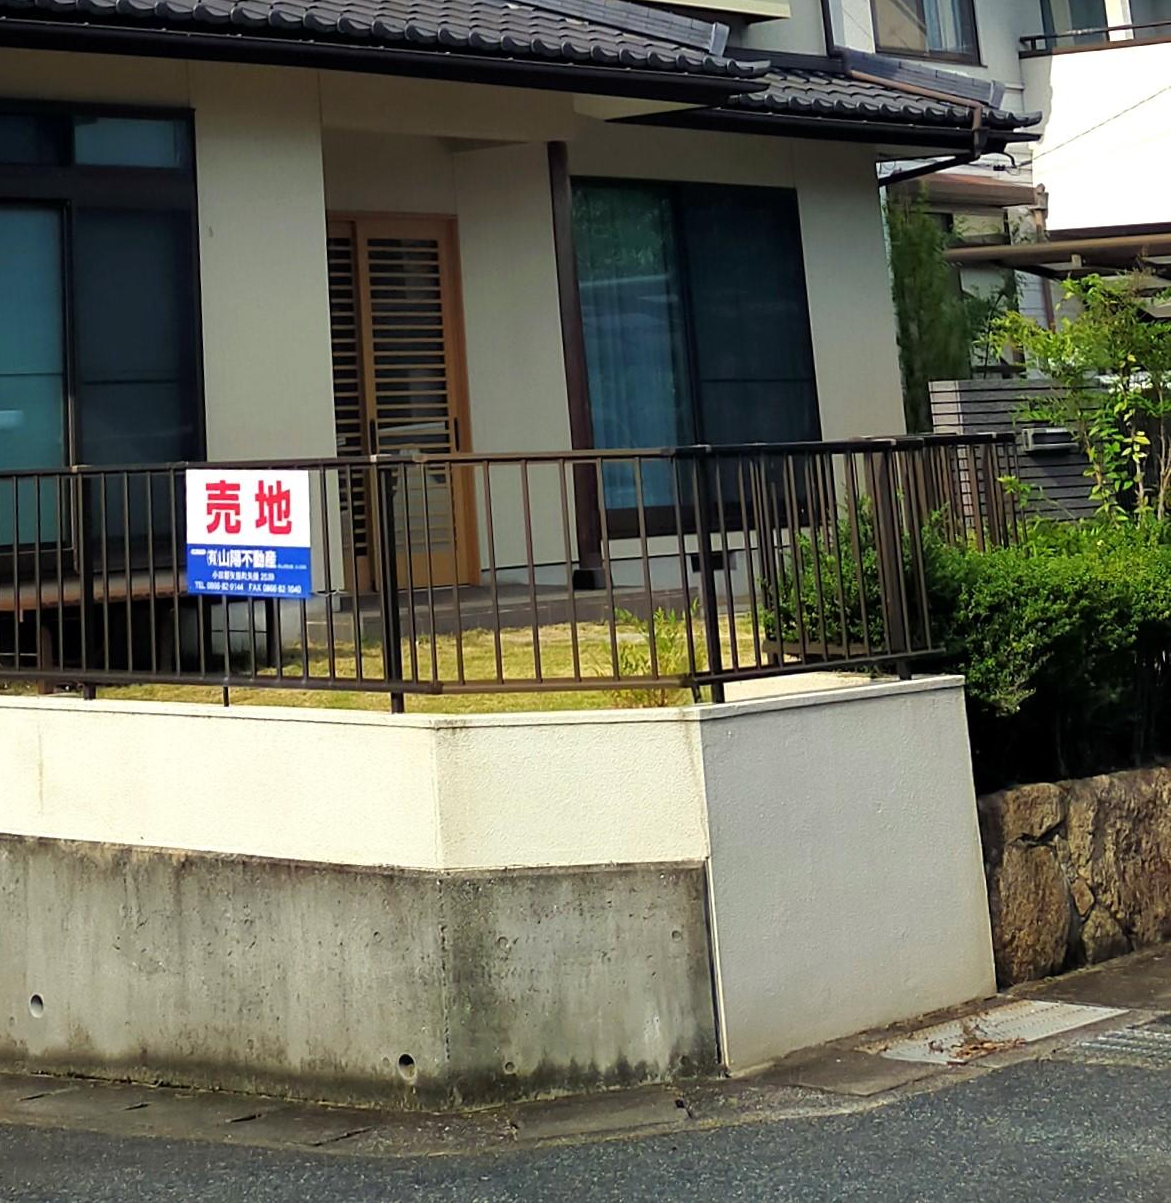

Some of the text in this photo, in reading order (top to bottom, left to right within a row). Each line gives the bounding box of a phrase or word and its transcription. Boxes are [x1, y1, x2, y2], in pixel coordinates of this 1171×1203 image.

[205, 479, 292, 535] 売地
[194, 580, 206, 590] TEL
[248, 582, 262, 592] FAX
